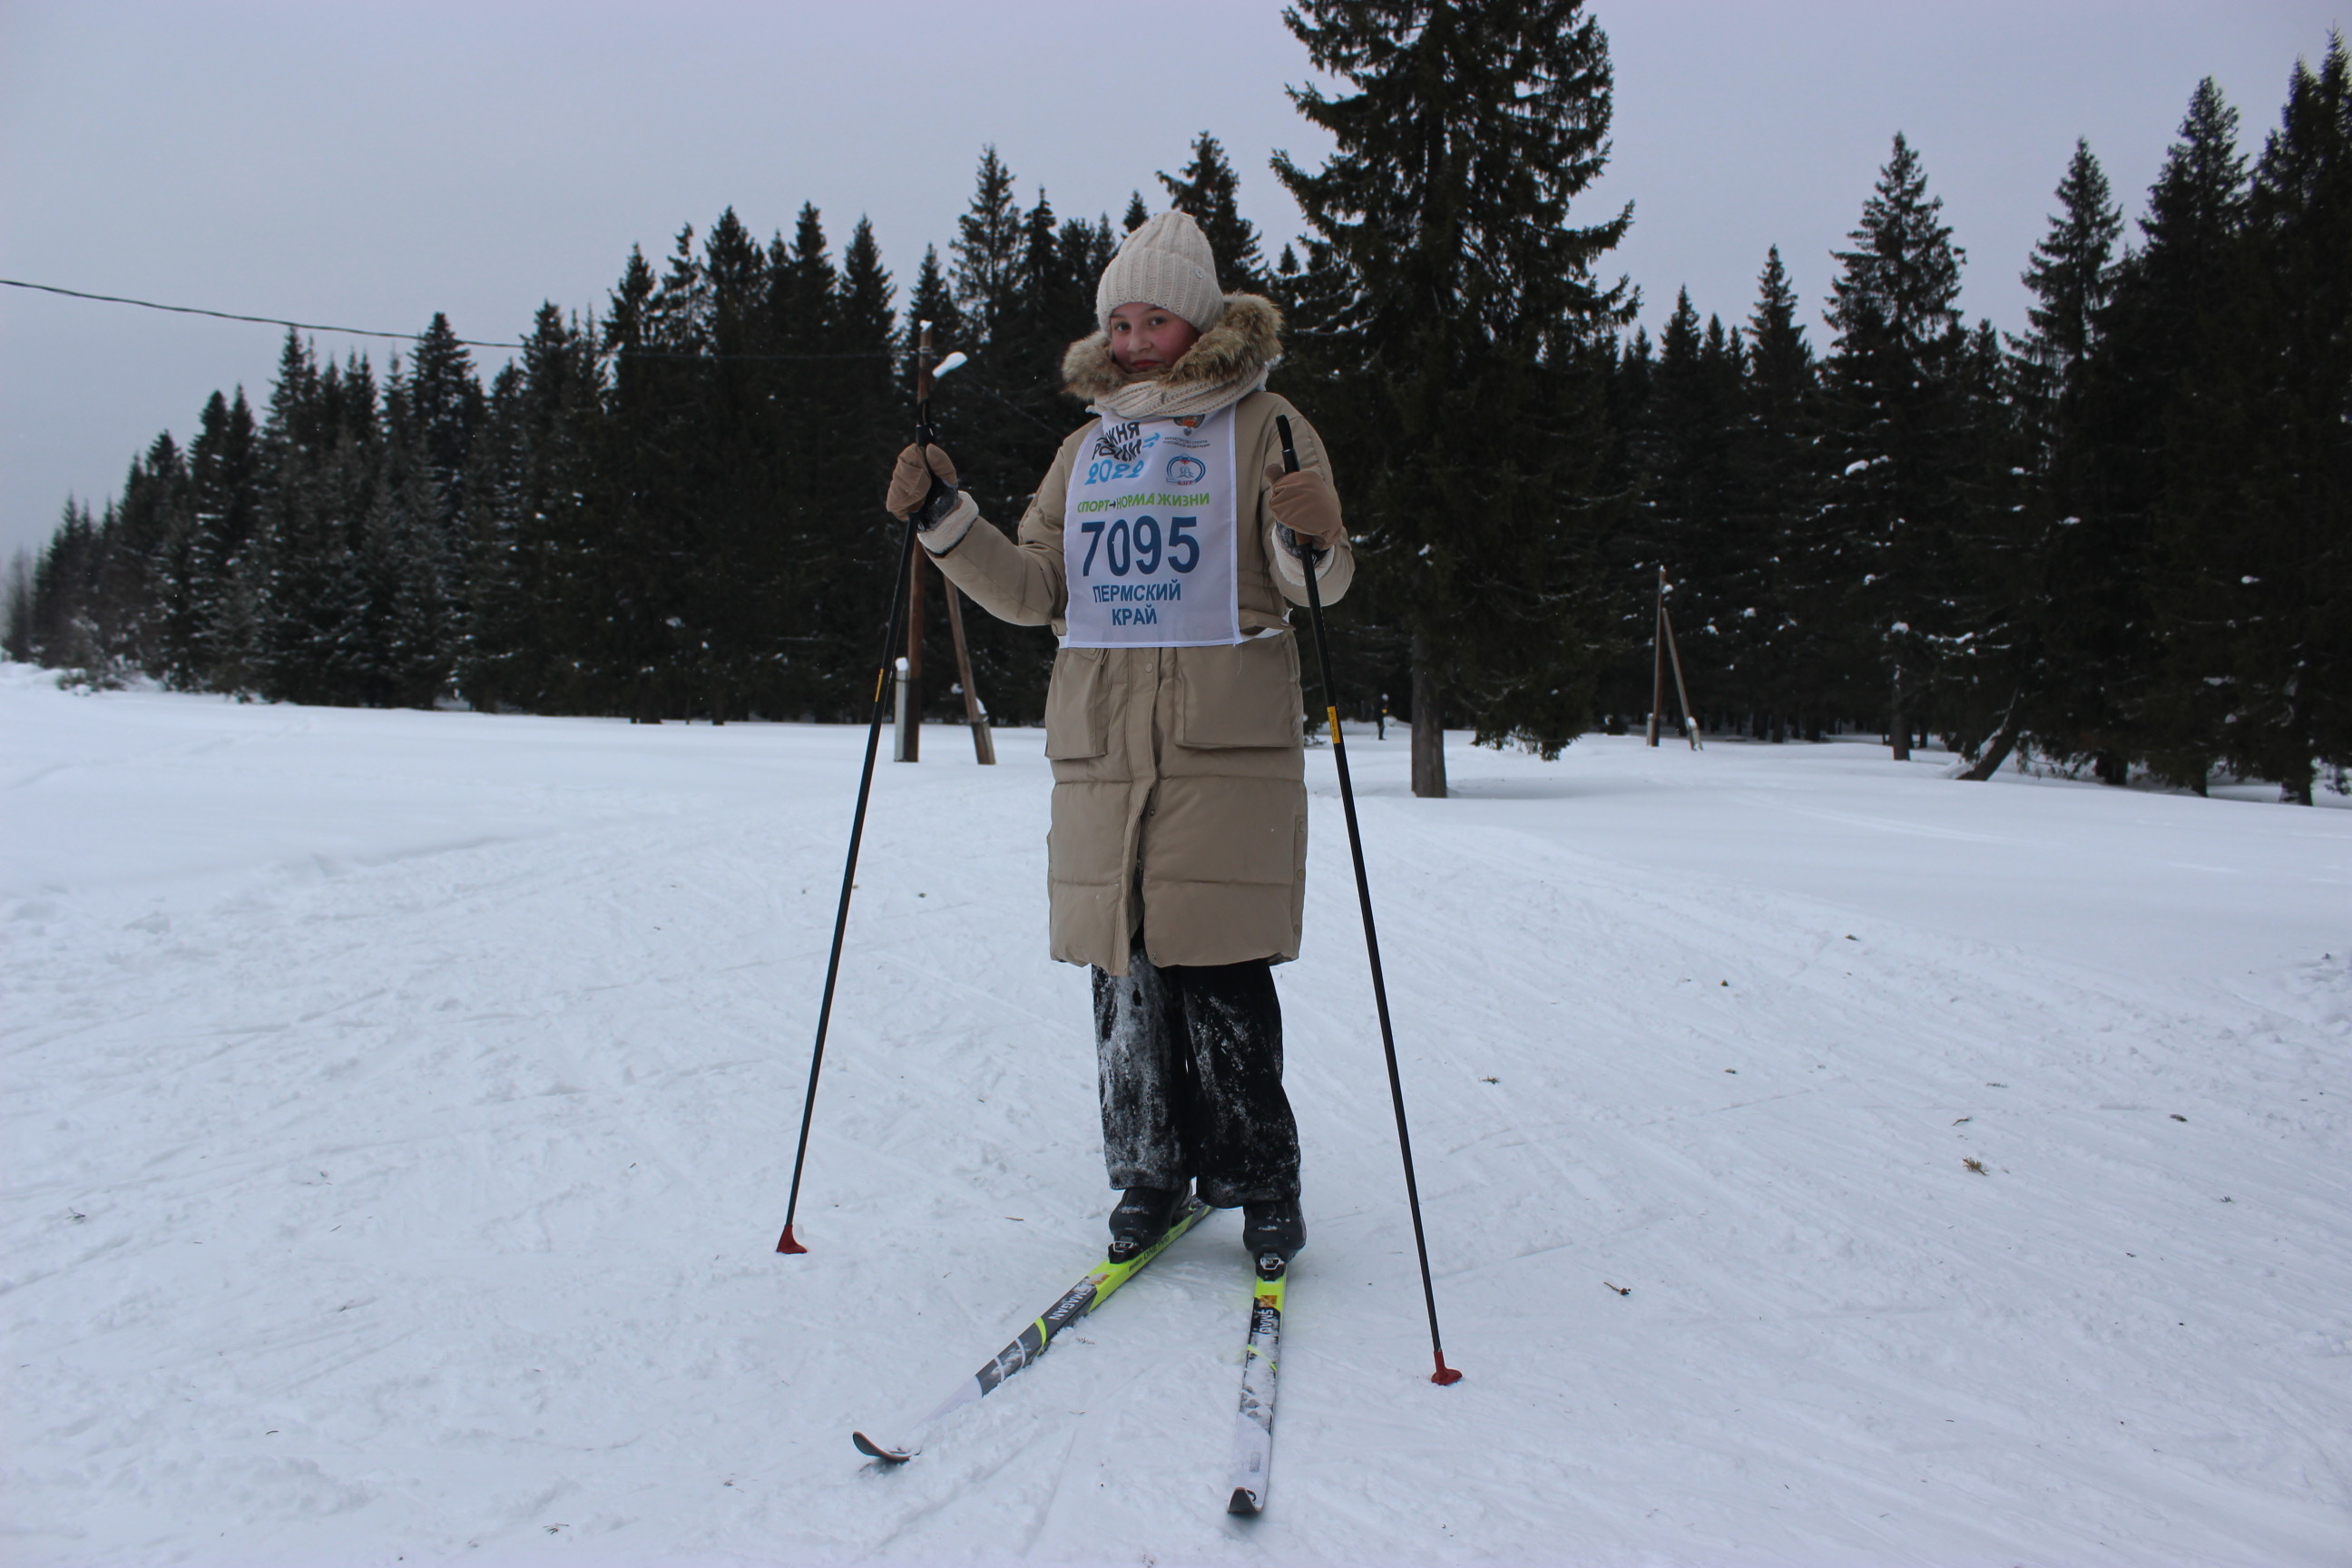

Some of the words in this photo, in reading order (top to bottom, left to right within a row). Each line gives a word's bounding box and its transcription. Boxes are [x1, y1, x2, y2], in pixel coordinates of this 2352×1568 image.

[1083, 459, 1145, 485] 2022
[1077, 500, 1111, 513] СПОРТ
[1116, 493, 1155, 510] НОРМА
[1157, 493, 1210, 508] ЖИЗНИ
[1081, 514, 1200, 577] 7095
[1092, 579, 1181, 603] ПЕРМСКИЙ
[1112, 603, 1158, 626] КРАЙ
[1259, 1308, 1274, 1335] SMAG
